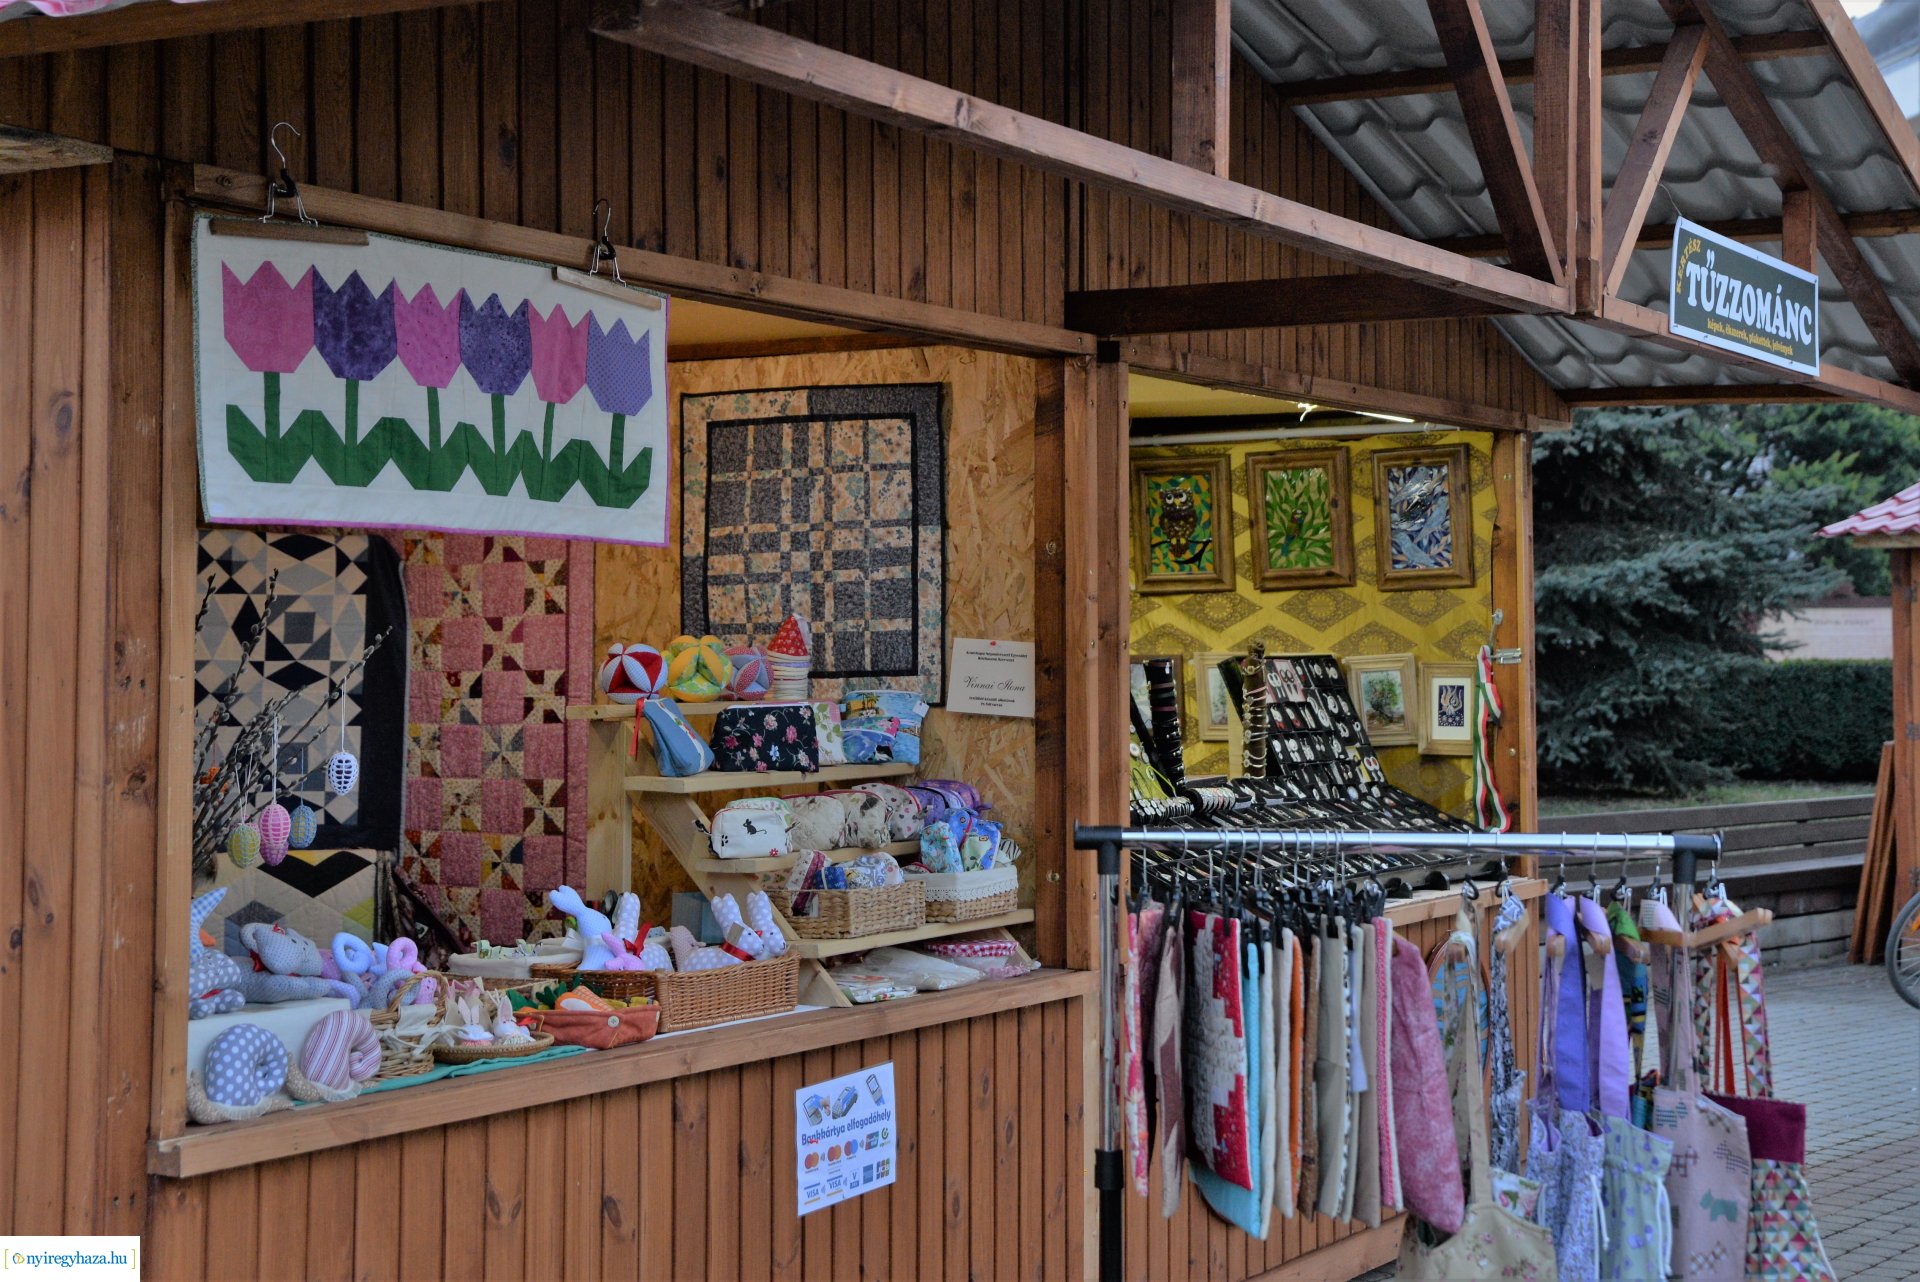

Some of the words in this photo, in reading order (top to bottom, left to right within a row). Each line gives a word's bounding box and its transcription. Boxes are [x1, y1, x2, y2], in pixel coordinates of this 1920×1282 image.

[1686, 249, 1812, 346] TŰZZOMÁNC
[802, 1125, 846, 1146] Bankkártya
[847, 1109, 891, 1131] elfogadóhely
[806, 1188, 820, 1198] VISA
[829, 1180, 842, 1189] VISA
